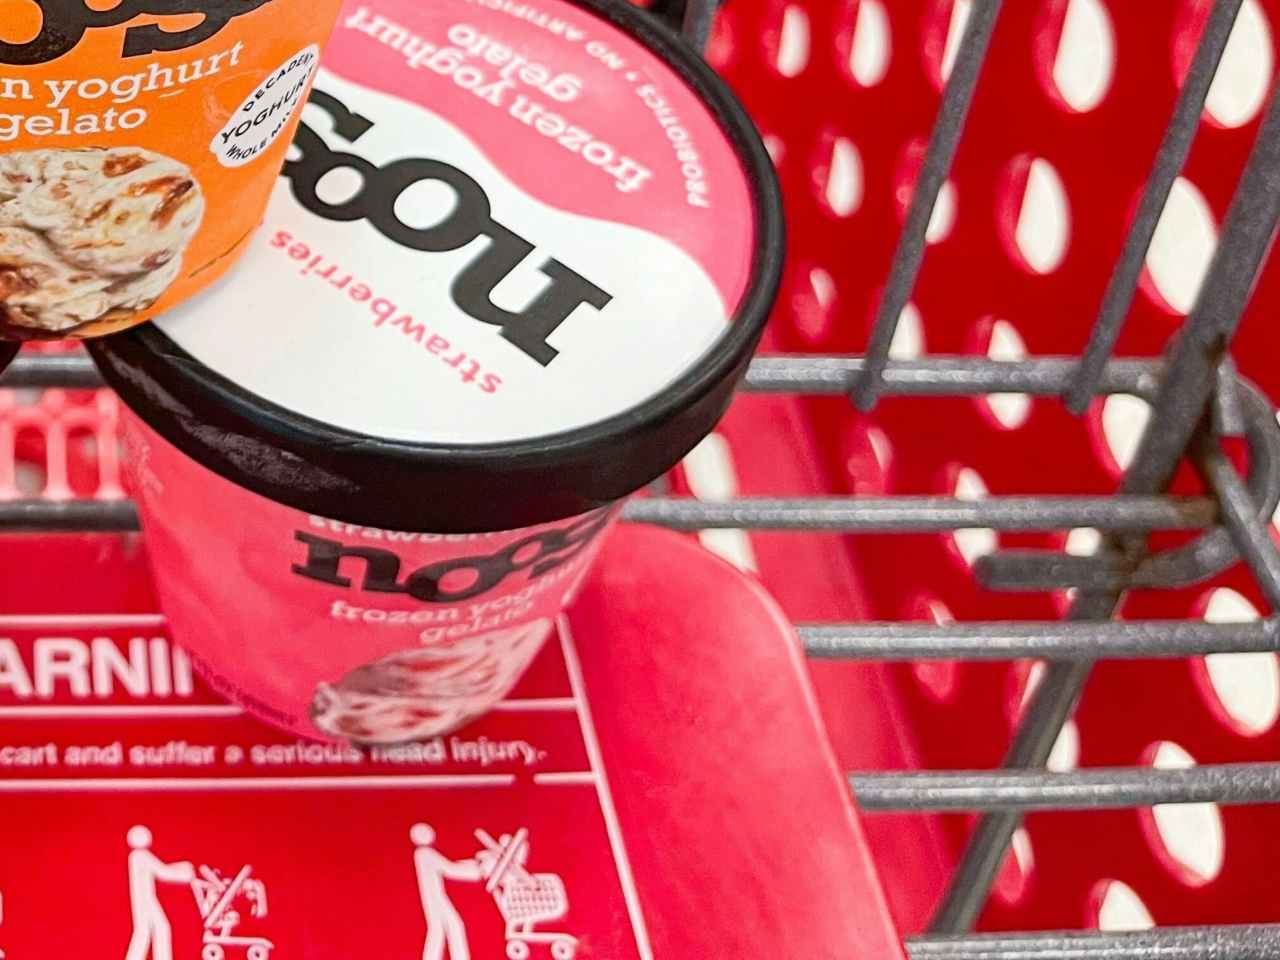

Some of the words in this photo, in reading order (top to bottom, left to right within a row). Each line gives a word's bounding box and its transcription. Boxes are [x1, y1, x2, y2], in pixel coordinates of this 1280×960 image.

[44, 41, 245, 110] yoghurt
[343, 6, 517, 107] yoghurt
[446, 23, 585, 103] gelato
[586, 40, 626, 68] NO
[508, 93, 655, 193] frozen
[637, 84, 710, 208] PROBIOTICS
[269, 230, 503, 395] strawberries
[331, 600, 459, 624] frozen
[0, 741, 58, 766] cart
[64, 741, 120, 766] and
[129, 741, 216, 766] suffer
[224, 746, 243, 765] a
[250, 741, 363, 765] serious
